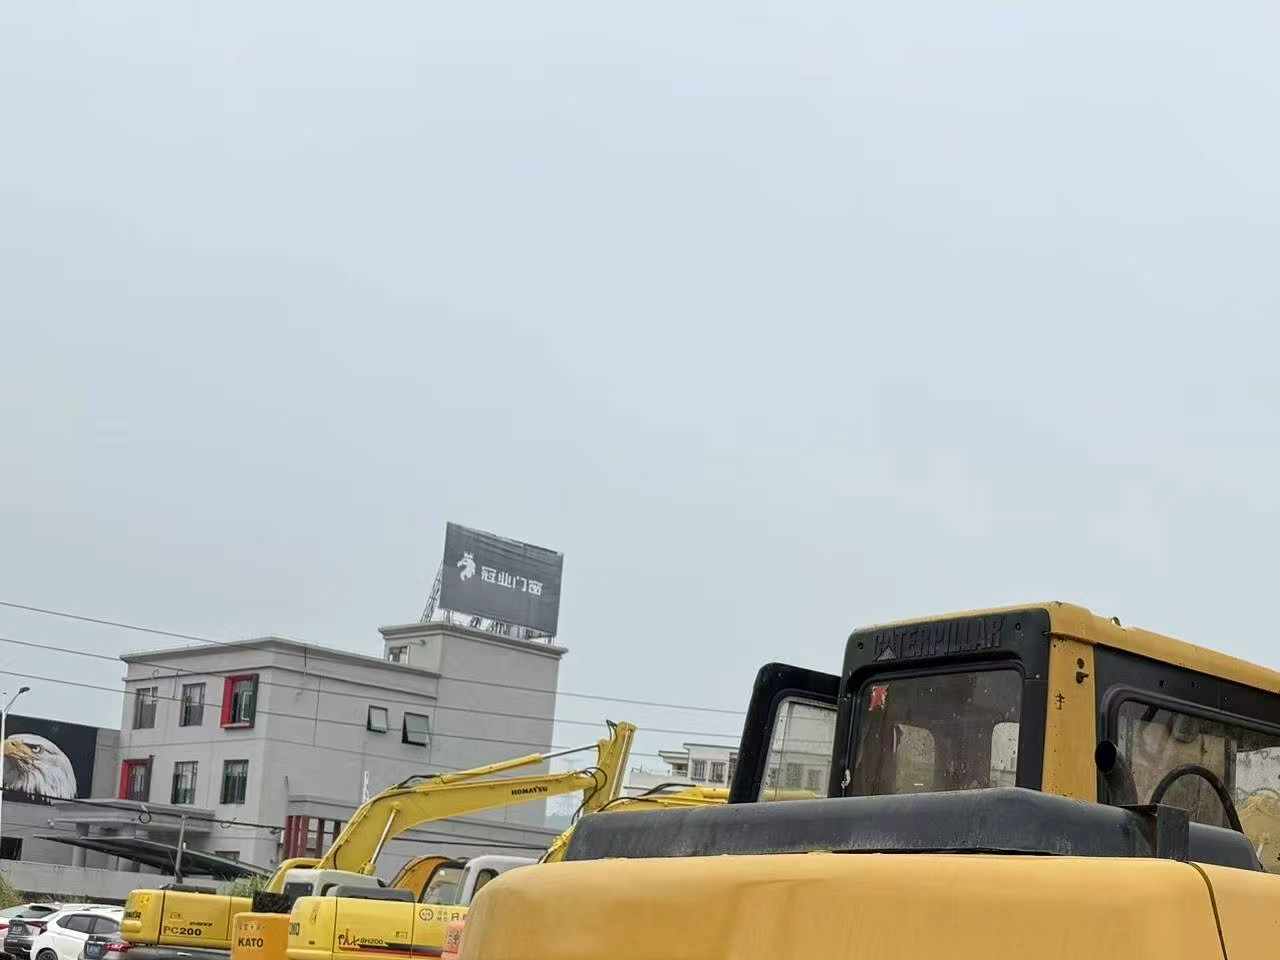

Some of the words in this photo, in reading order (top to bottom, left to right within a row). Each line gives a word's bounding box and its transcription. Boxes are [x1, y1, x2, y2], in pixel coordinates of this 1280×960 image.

[872, 617, 1004, 663] CATERPILLAR
[163, 924, 202, 936] PC200
[238, 937, 264, 948] KATO
